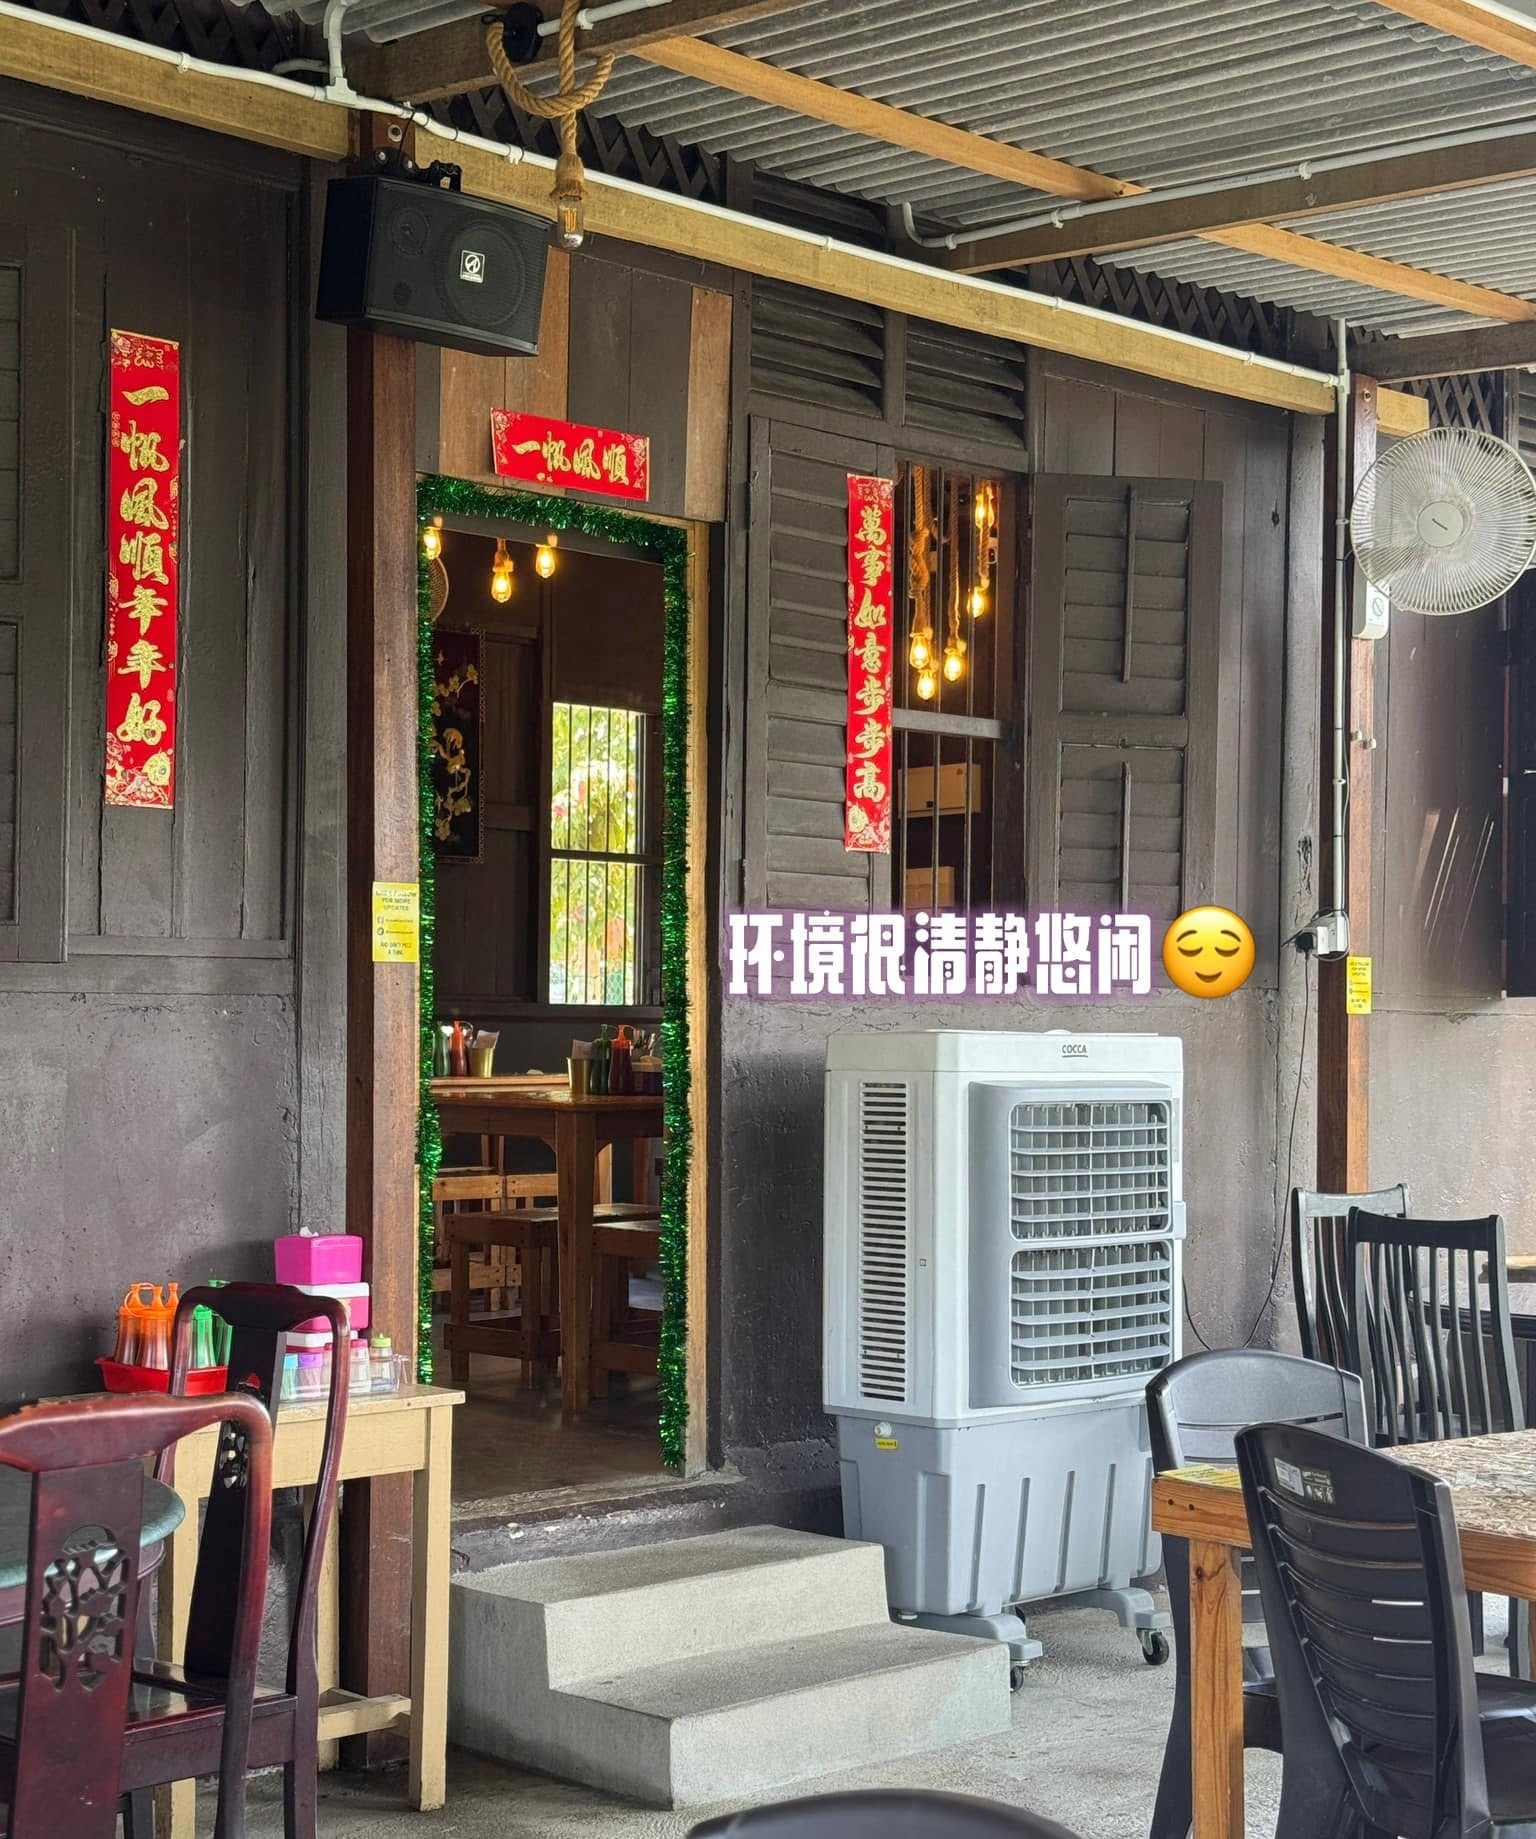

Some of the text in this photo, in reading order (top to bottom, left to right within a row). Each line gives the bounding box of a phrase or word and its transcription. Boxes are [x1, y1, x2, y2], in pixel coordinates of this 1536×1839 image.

[512, 430, 629, 486] 一帆風順
[116, 385, 170, 746] 一帆風順年年好
[853, 505, 887, 803] 萬事如意步步高
[1062, 1044, 1087, 1054] COCCA
